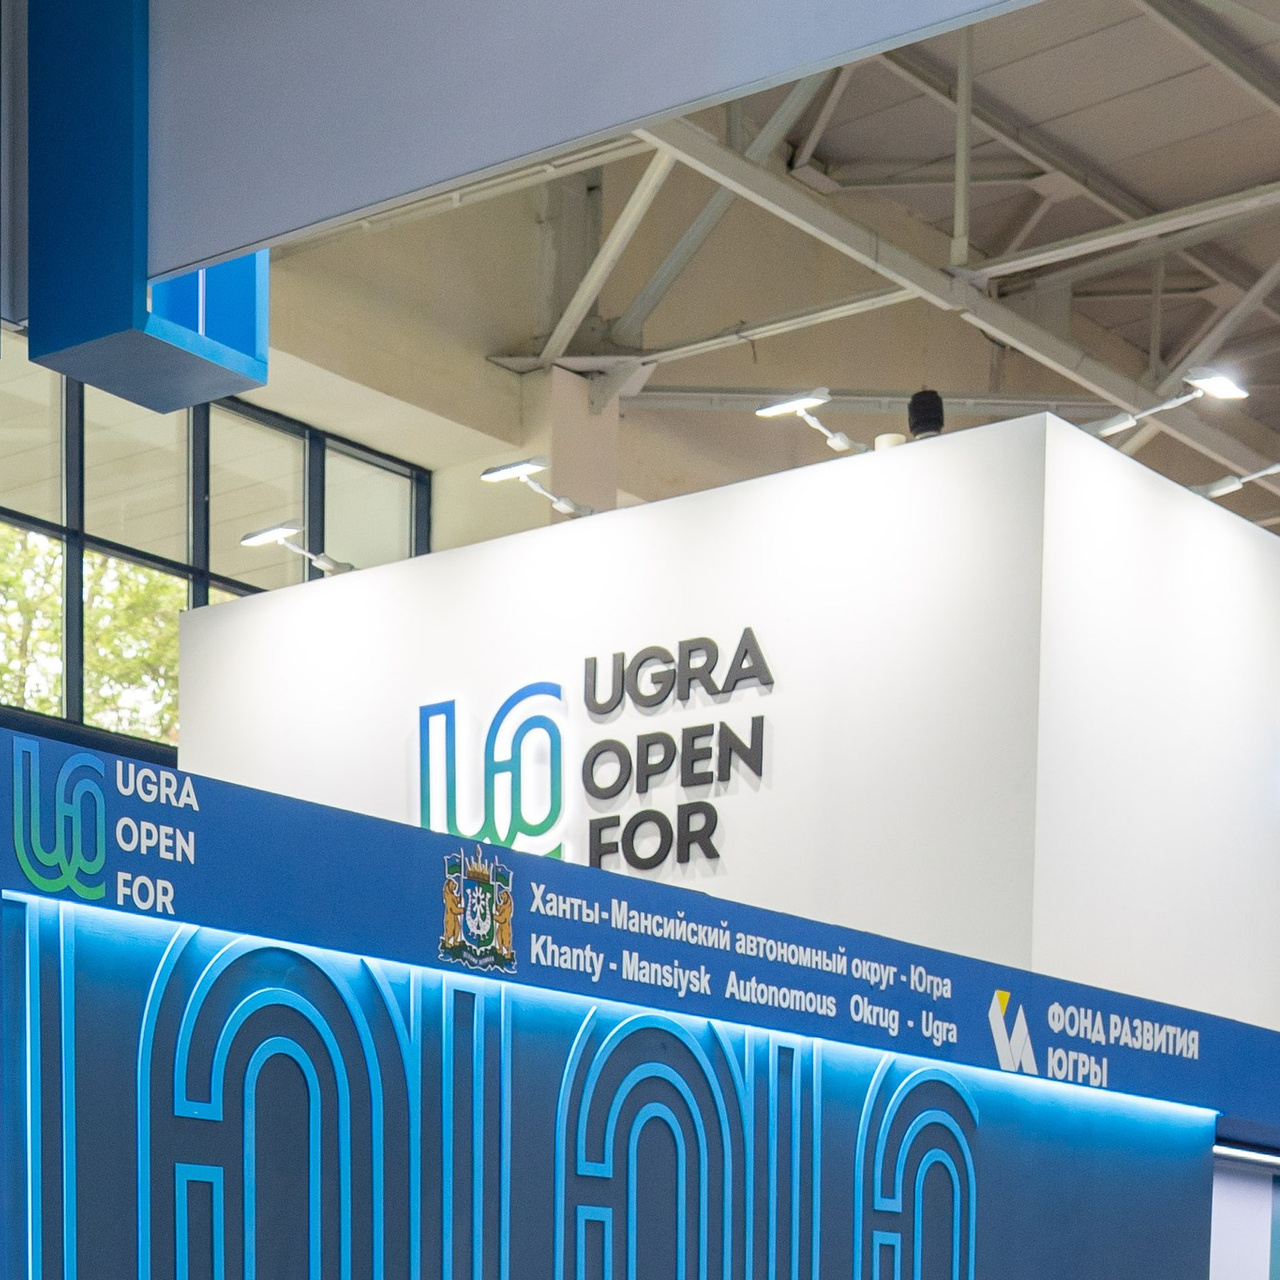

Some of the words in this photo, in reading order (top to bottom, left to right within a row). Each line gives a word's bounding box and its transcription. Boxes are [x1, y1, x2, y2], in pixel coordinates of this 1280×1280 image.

[583, 626, 775, 715] UGRA
[115, 759, 200, 812] UGRA
[581, 715, 765, 800] OPEN
[115, 816, 195, 865] OPEN
[588, 801, 721, 871] FOR
[116, 871, 176, 916] FOR
[530, 933, 604, 983] Khanty
[622, 950, 712, 998] Mansiysk
[724, 970, 837, 1018] Autonomous
[850, 994, 900, 1037] Okrug
[921, 1010, 958, 1047] Ugra
[735, 932, 847, 976] автономный
[851, 957, 898, 991] округ
[910, 964, 952, 1001] Югра
[1047, 1001, 1106, 1046] ФОНД
[1109, 1013, 1200, 1061] РАЗВИТИЯ
[1047, 1046, 1108, 1088] ЮГРЫ
